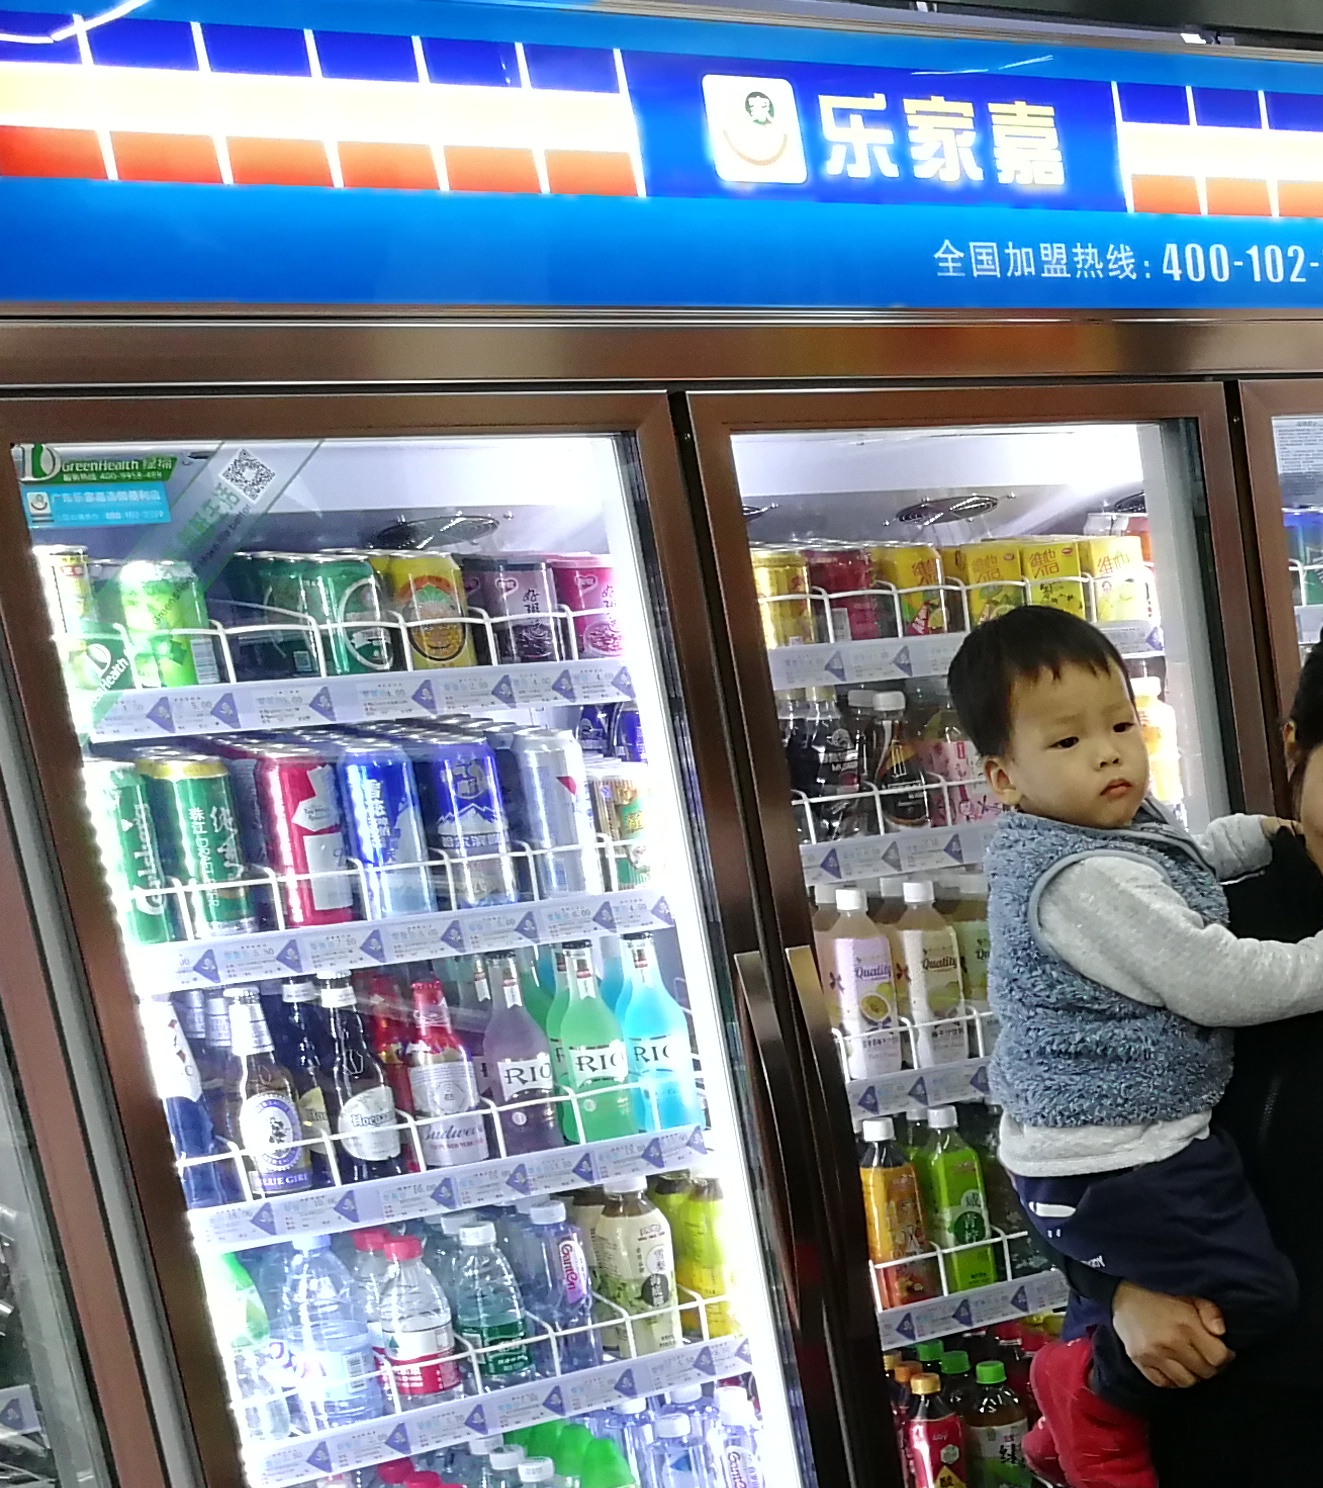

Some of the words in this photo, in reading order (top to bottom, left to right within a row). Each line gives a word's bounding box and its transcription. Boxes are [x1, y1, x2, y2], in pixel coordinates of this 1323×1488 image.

[818, 90, 1067, 189] 乐家嘉
[933, 239, 1153, 282] 全国加盟热线:
[854, 965, 892, 980] Quality
[922, 956, 957, 970] Quality
